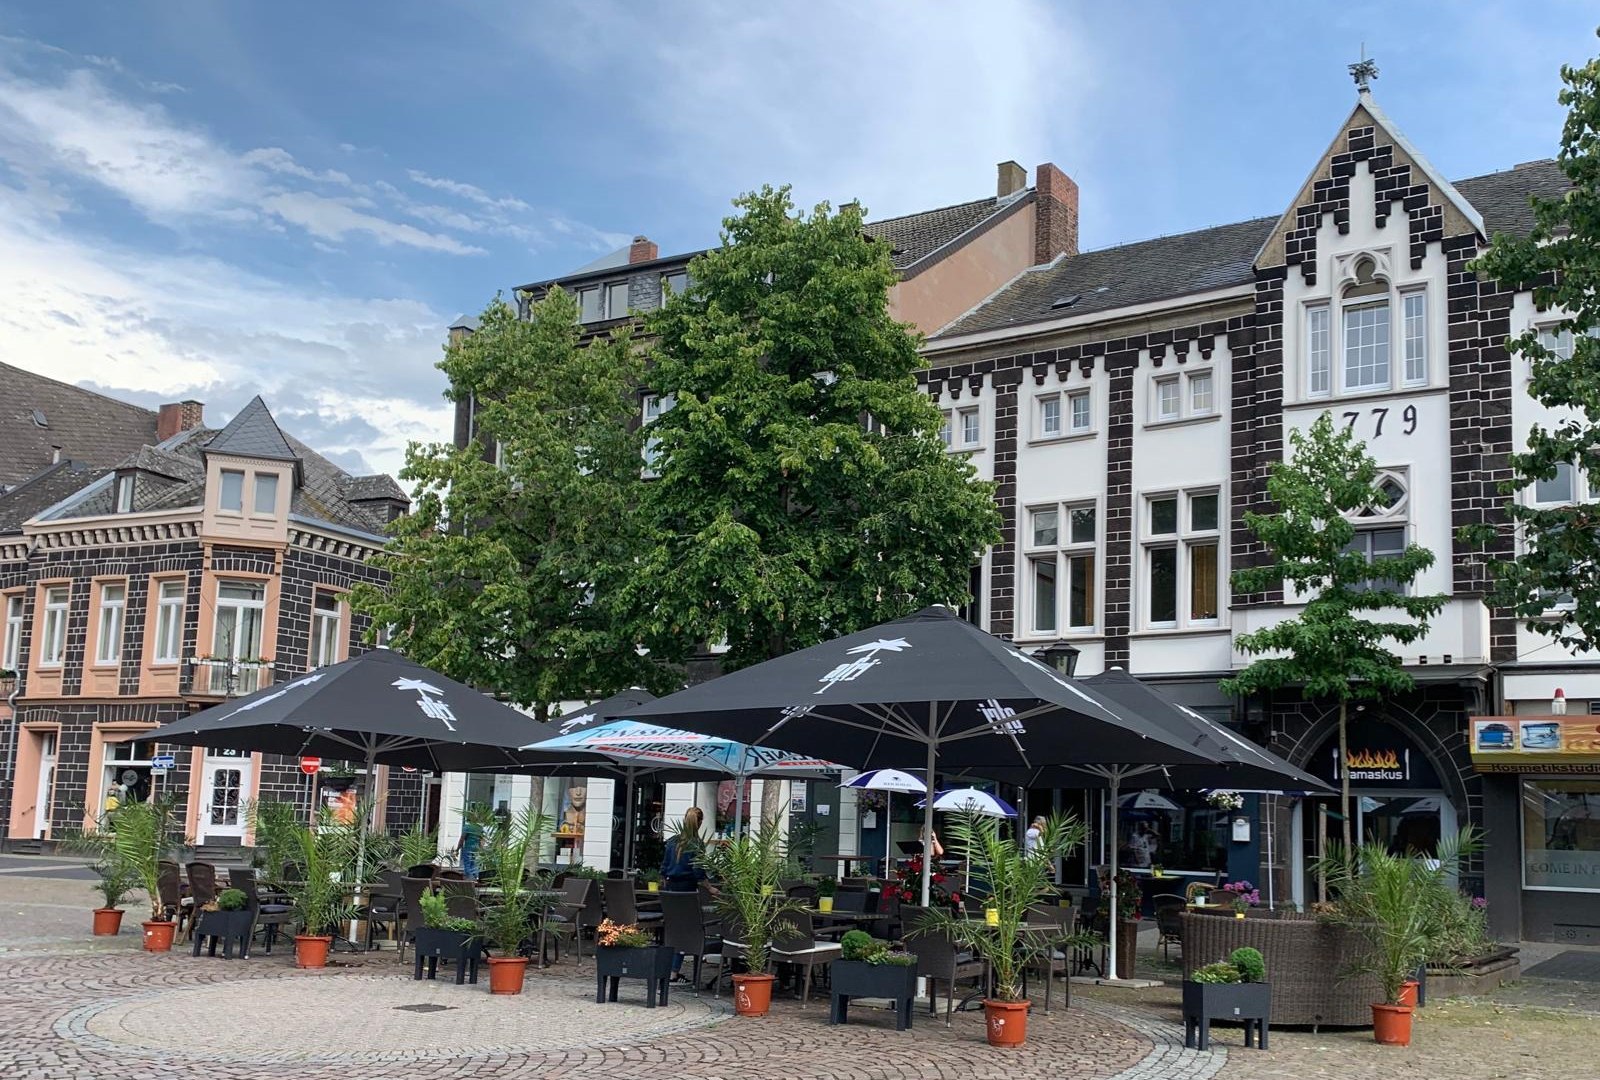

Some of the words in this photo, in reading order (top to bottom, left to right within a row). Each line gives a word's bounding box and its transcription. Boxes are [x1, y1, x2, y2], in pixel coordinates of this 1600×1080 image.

[1317, 404, 1417, 440] 779
[1491, 763, 1600, 773] Kosmetikstudi
[723, 789, 750, 803] SA
[1530, 862, 1570, 874] COME
[1574, 863, 1588, 874] IN
